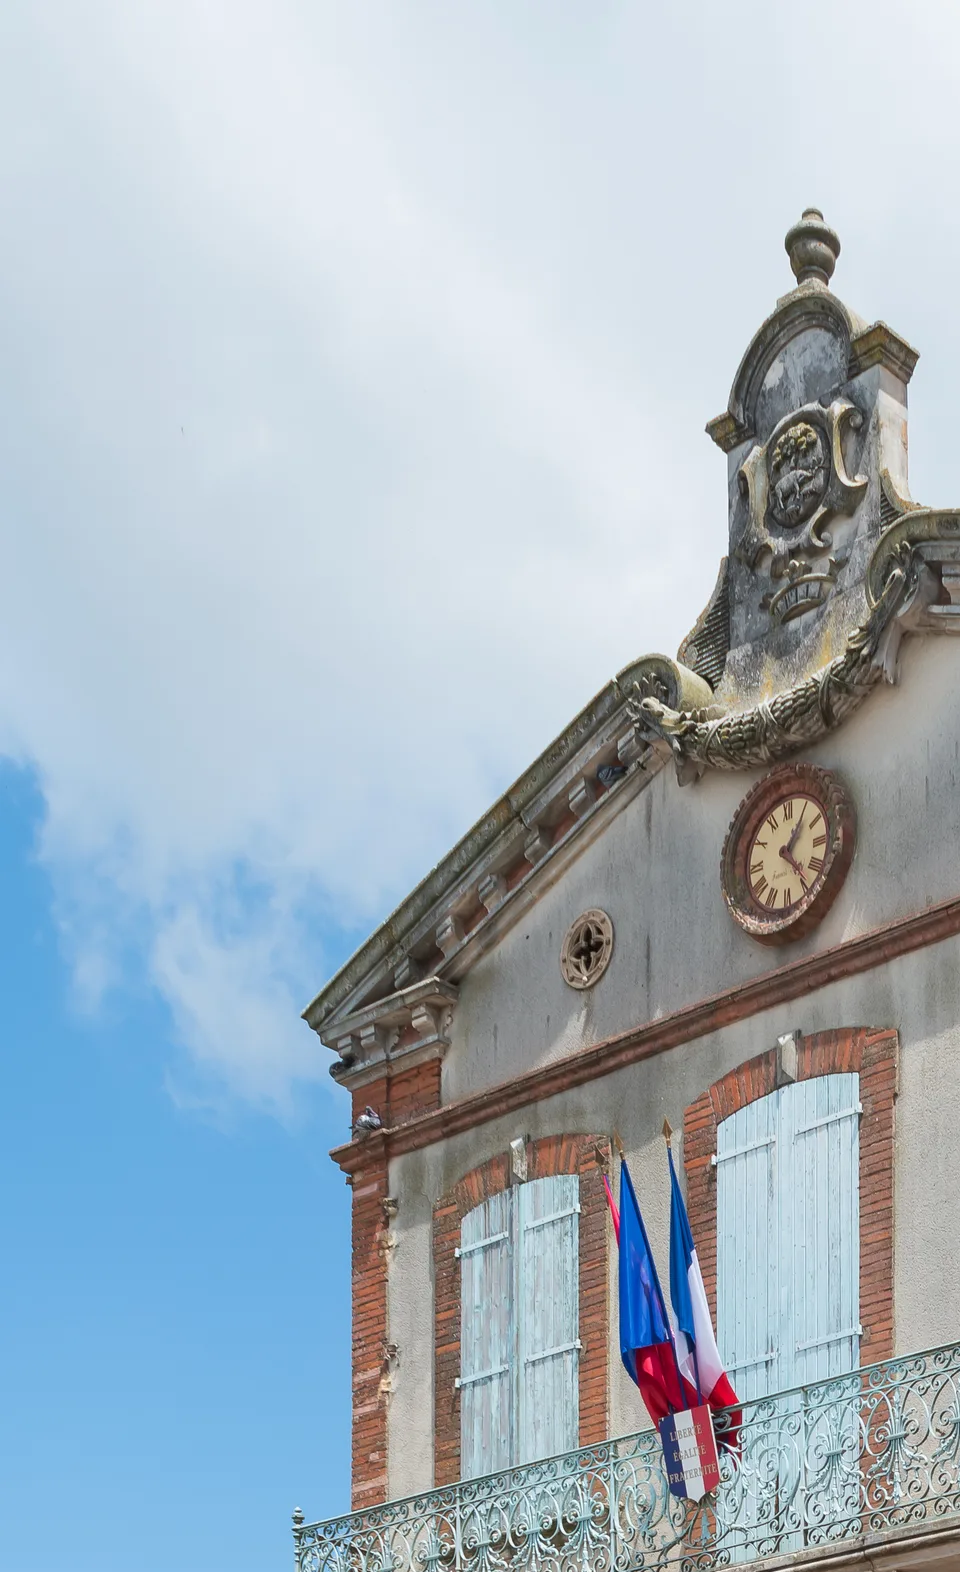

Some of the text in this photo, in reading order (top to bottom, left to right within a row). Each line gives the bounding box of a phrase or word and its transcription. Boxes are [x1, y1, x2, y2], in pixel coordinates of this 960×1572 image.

[783, 800, 793, 822] XII
[766, 814, 779, 833] XI
[809, 812, 822, 830] II
[754, 839, 768, 849] X
[812, 834, 826, 848] III
[750, 860, 764, 874] IX
[807, 856, 823, 872] IIII
[764, 887, 778, 908] VII
[669, 1422, 703, 1442] LIBERTÉ
[673, 1443, 707, 1462] ÉGALITÉ
[669, 1461, 718, 1484] FRATERNITÉ
